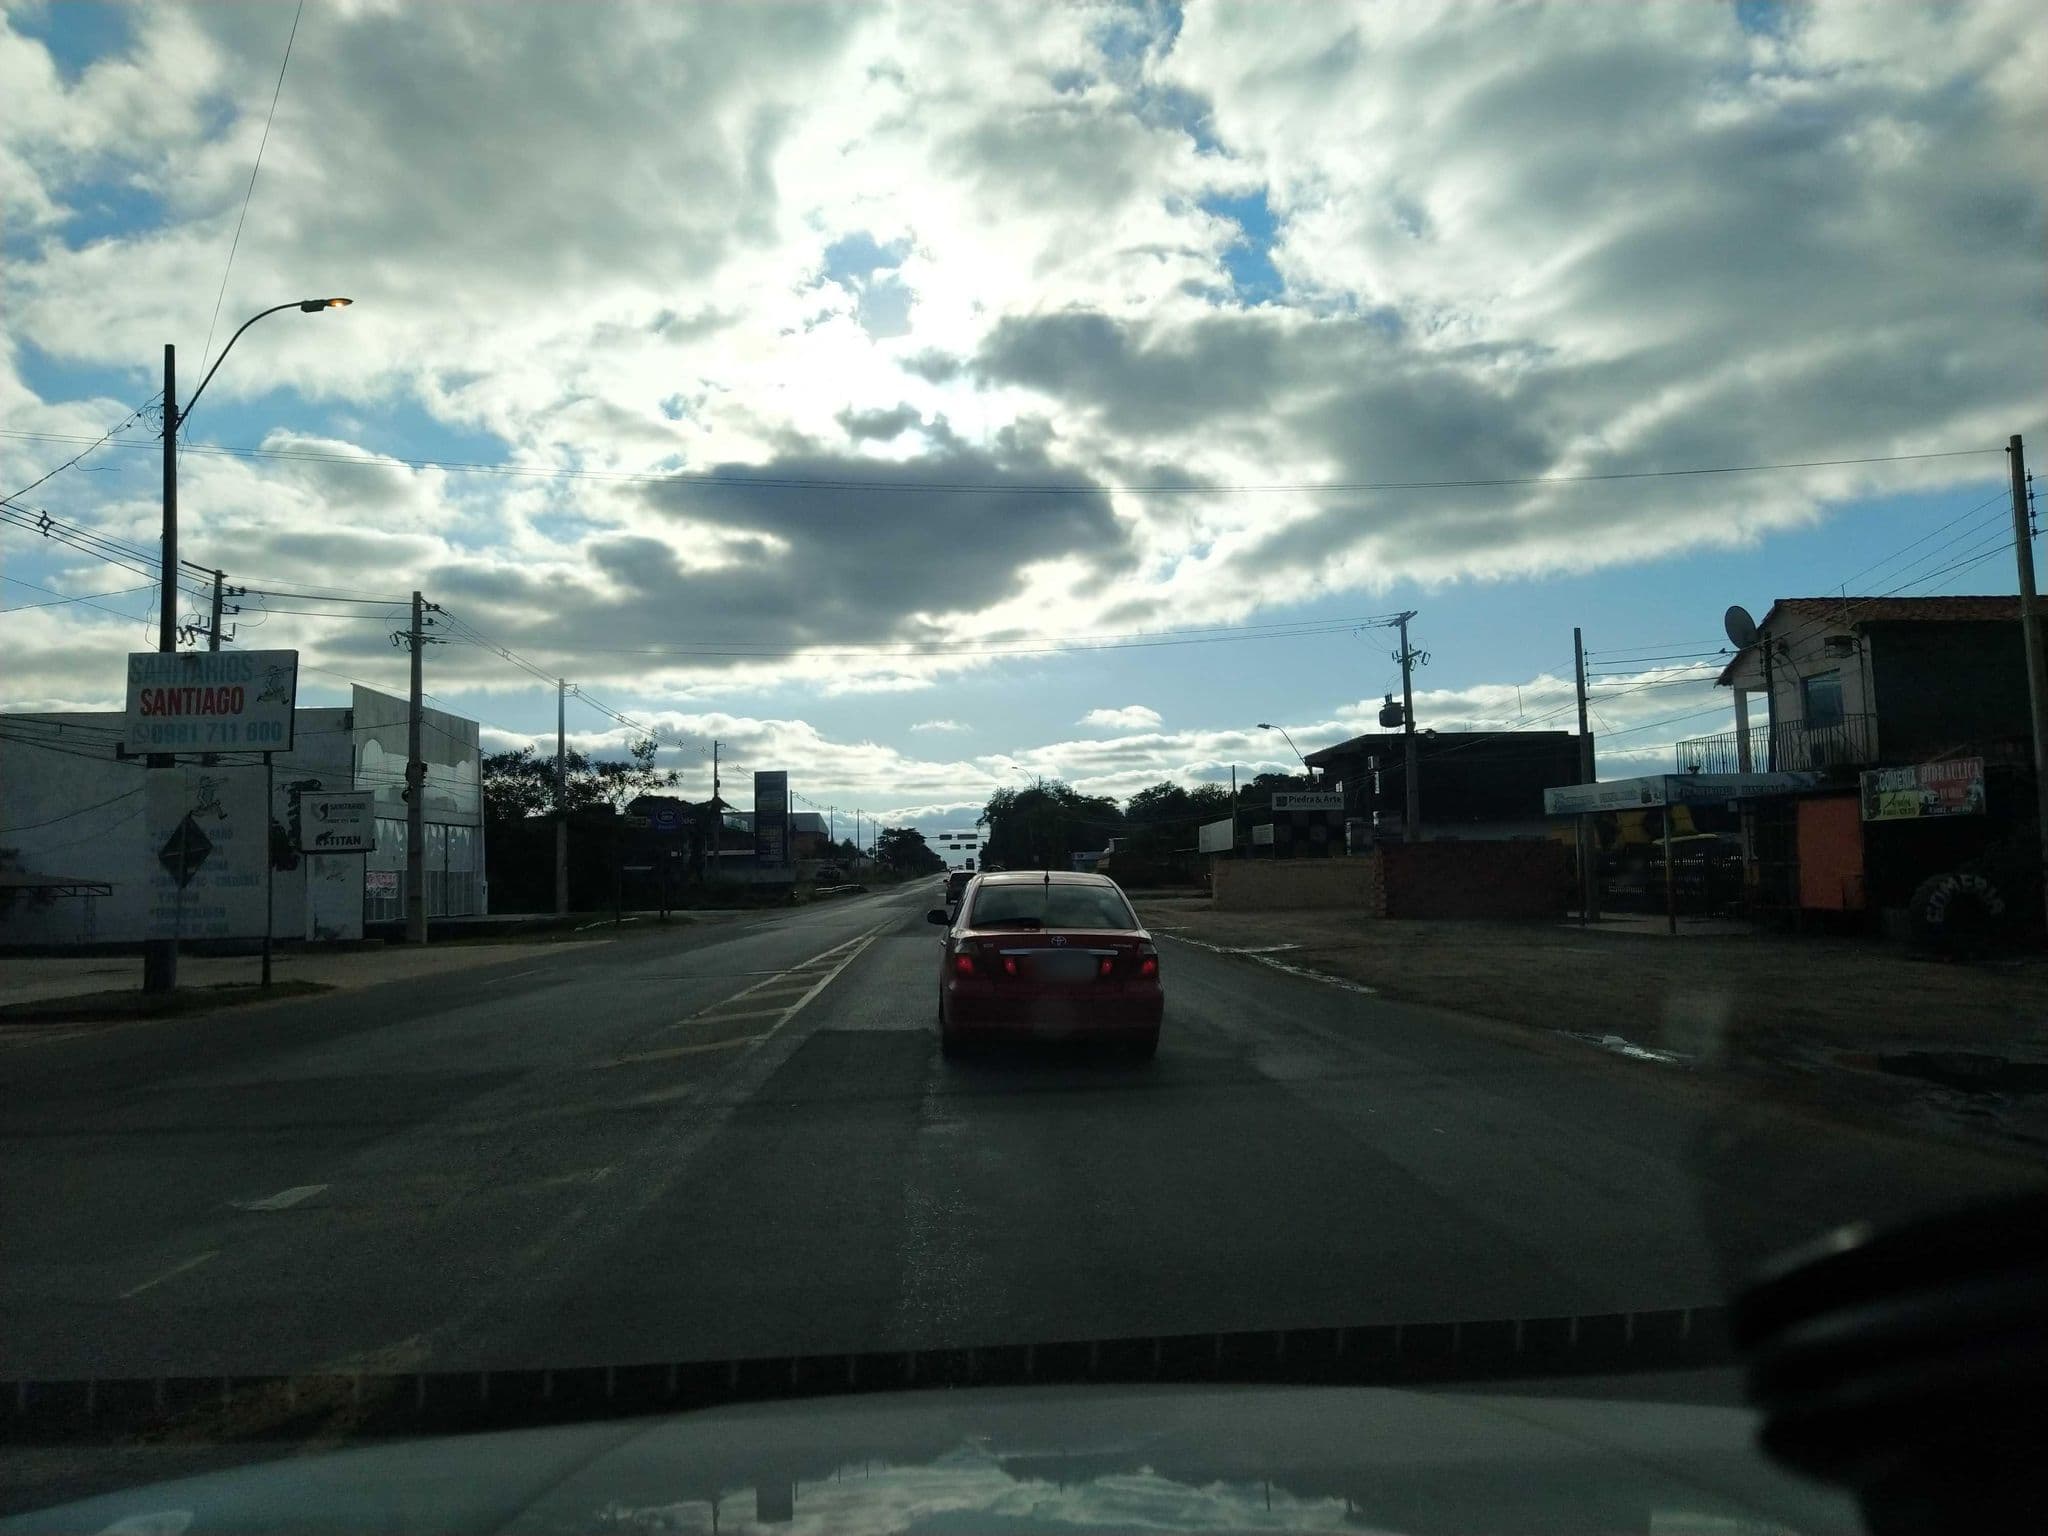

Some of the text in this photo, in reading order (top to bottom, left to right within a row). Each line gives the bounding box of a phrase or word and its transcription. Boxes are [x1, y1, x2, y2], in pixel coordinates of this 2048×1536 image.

[140, 687, 245, 717] SANTIAGO
[206, 721, 238, 743] 711
[1288, 795, 1315, 804] Piedra
[1323, 795, 1342, 804] Arte
[329, 836, 362, 846] TITAN
